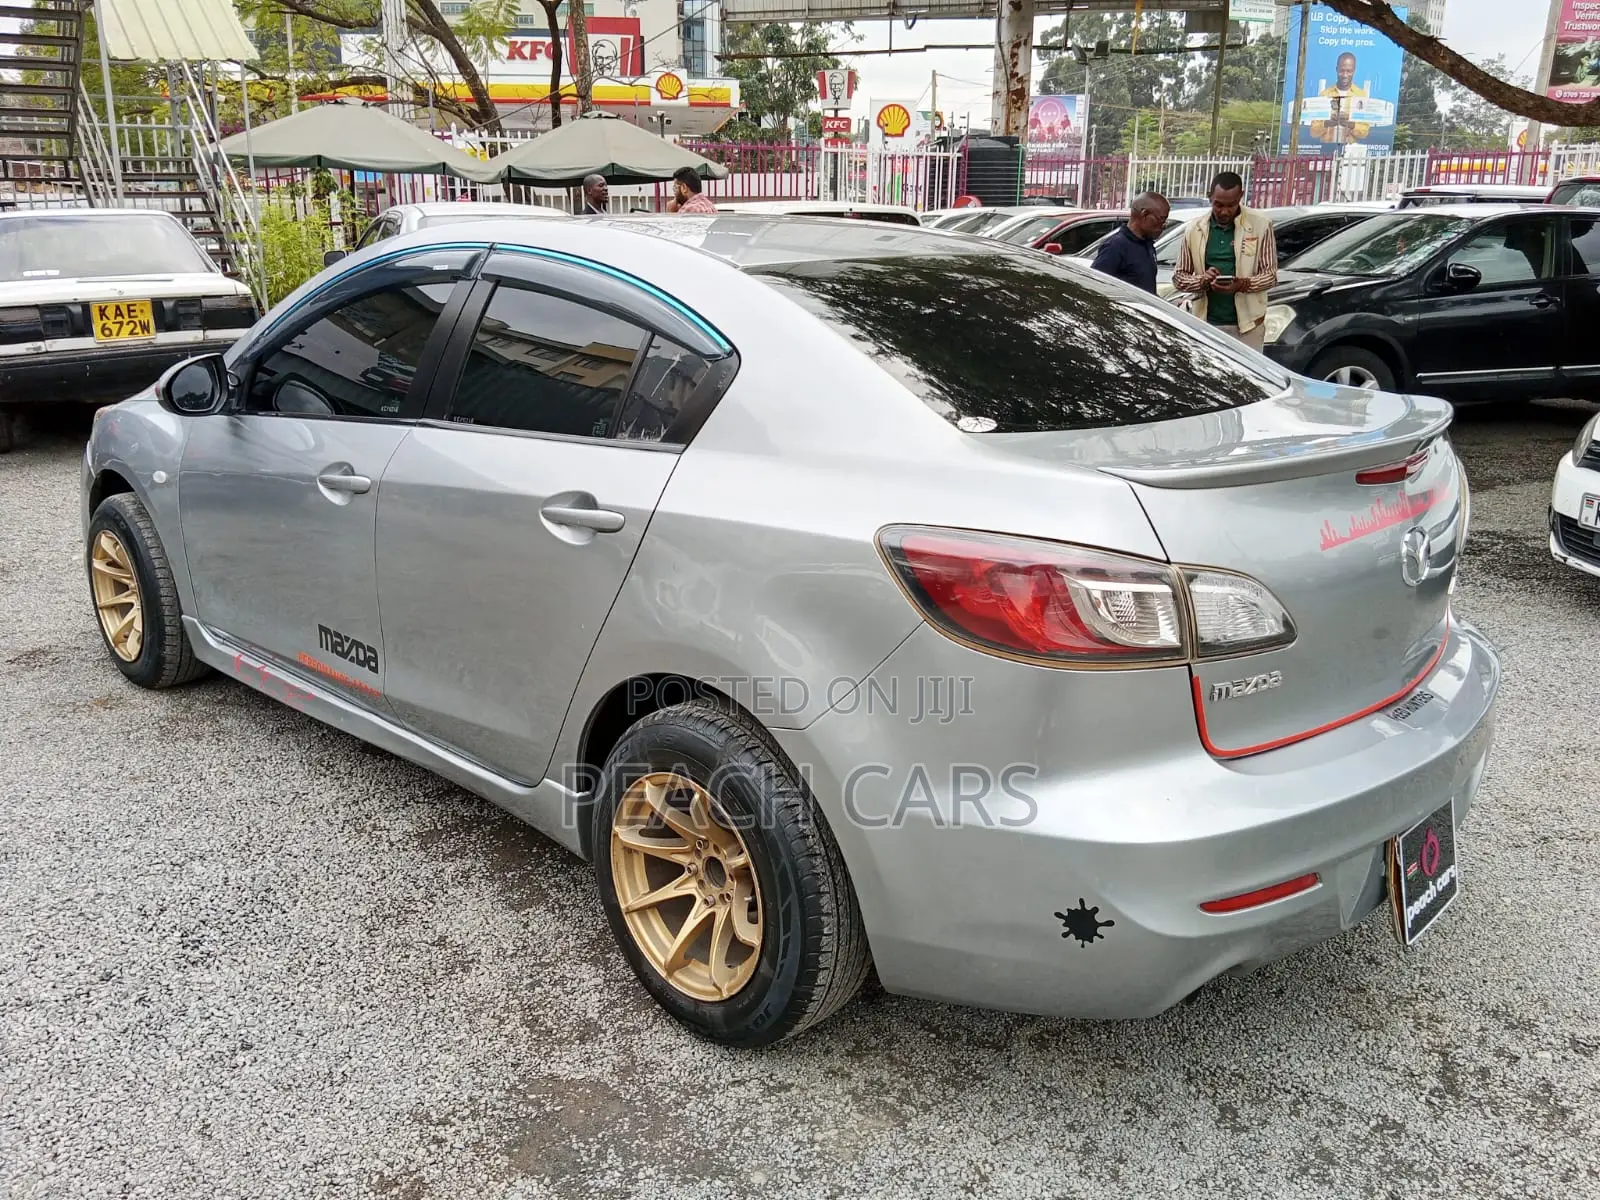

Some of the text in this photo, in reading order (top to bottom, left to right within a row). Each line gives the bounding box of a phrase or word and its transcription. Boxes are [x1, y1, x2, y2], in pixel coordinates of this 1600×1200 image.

[1339, 26, 1353, 34] the
[1318, 36, 1339, 47] Copy
[1340, 38, 1354, 46] the
[824, 120, 848, 129] KFC
[98, 303, 139, 321] KAE
[100, 319, 152, 338] 672W
[1406, 864, 1457, 929] peach cars
